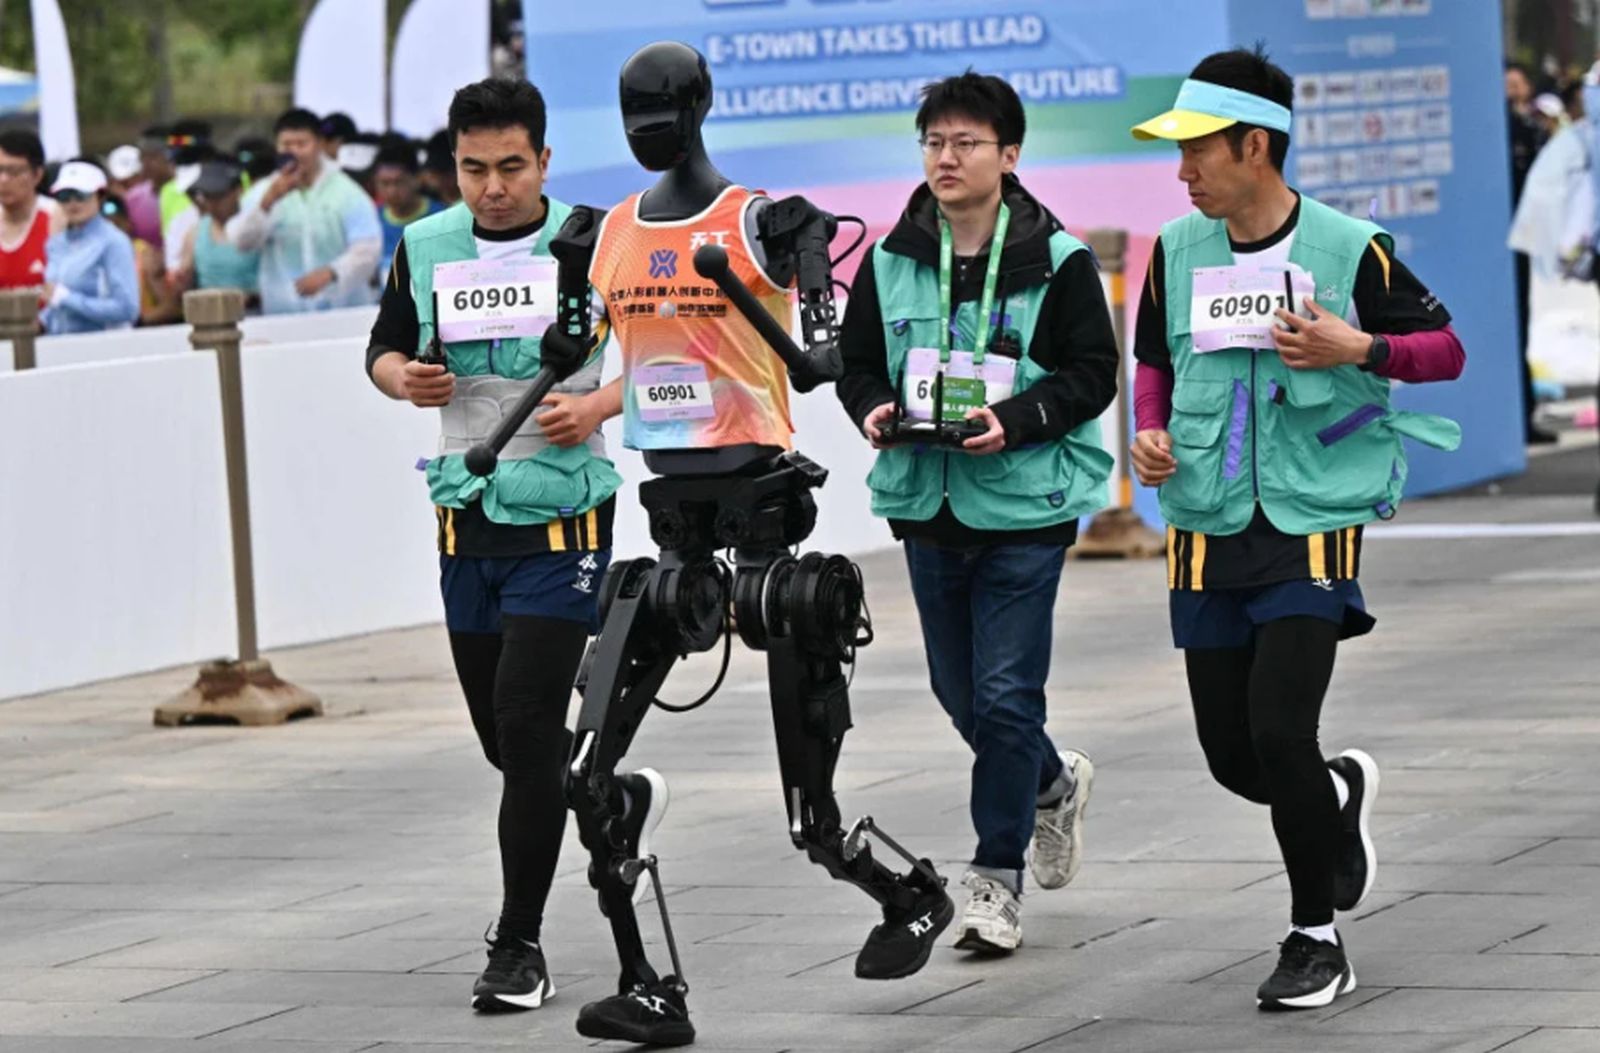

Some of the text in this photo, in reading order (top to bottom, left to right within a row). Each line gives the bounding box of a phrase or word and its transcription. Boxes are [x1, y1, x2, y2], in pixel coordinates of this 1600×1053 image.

[706, 15, 1043, 63] E-TOWN TAKES THE LEAD
[1009, 65, 1118, 99] FUTURE
[453, 285, 534, 311] 60901
[1209, 294, 1285, 319] 60901
[648, 384, 697, 402] 60901
